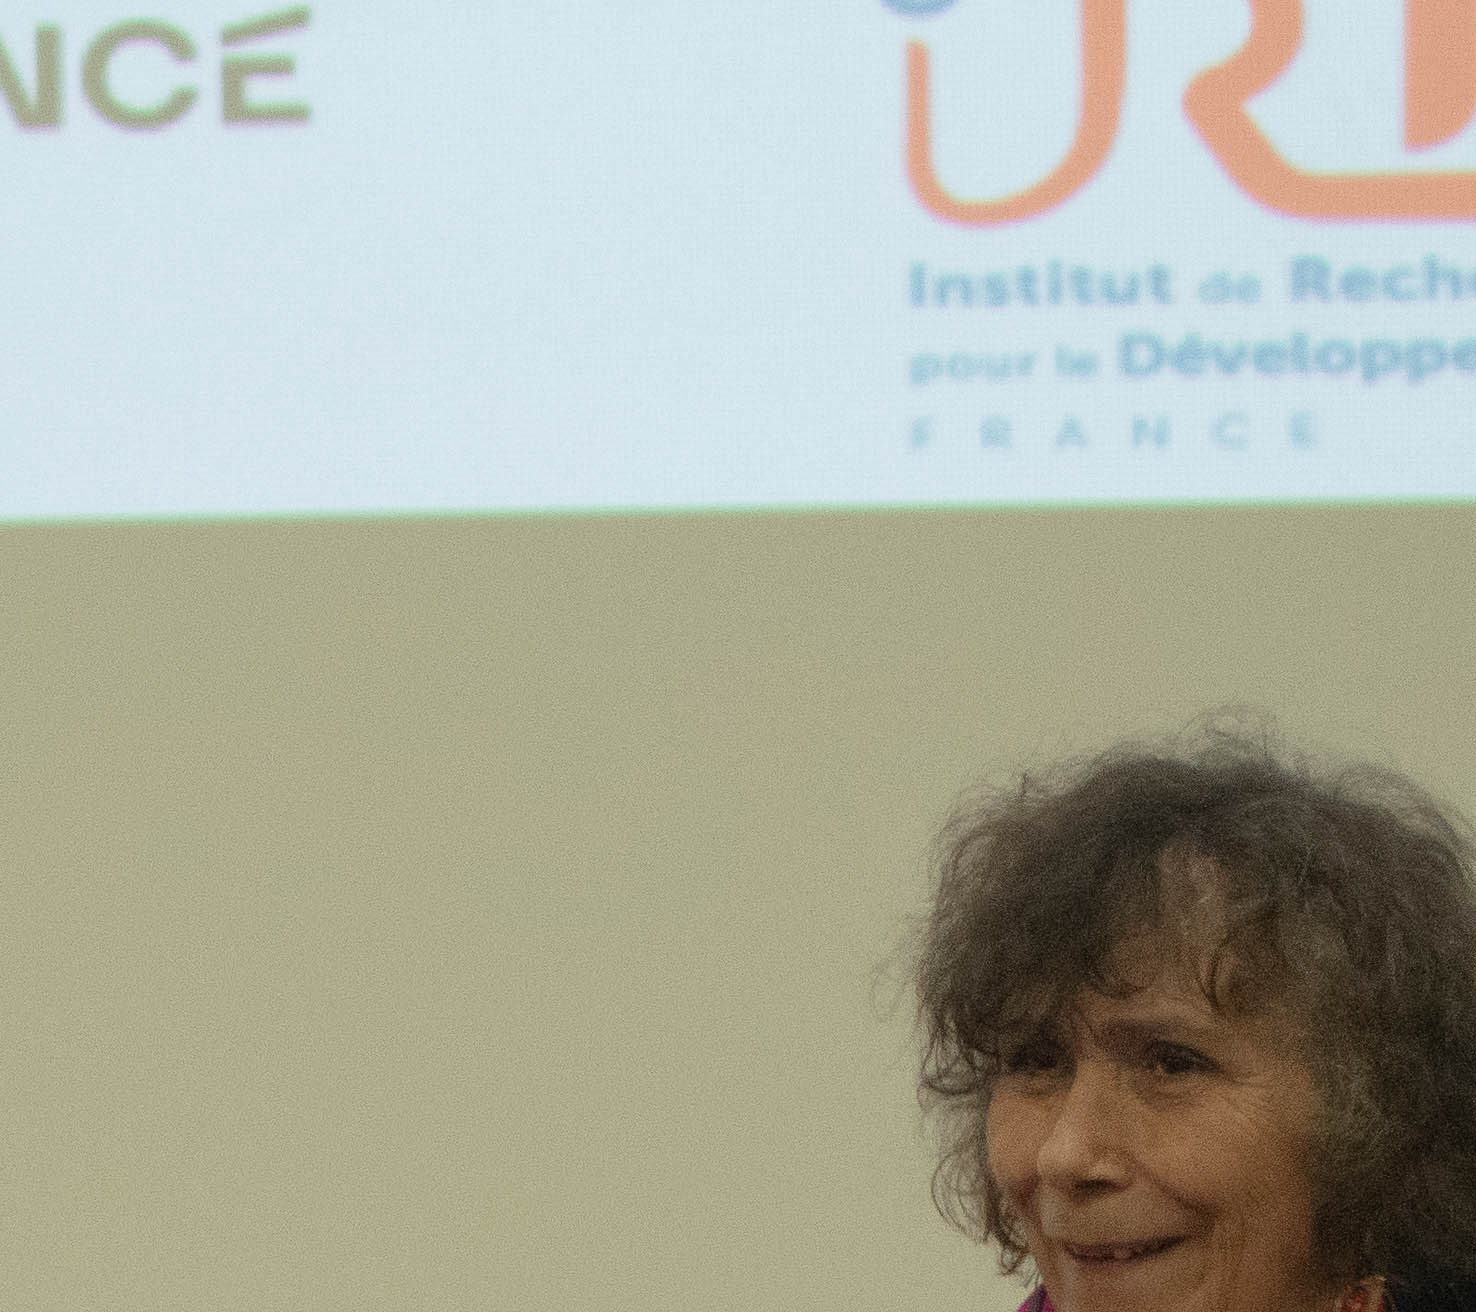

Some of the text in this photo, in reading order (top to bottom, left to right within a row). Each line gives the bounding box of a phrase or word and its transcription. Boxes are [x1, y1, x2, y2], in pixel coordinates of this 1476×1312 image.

[908, 259, 1174, 308] Institut
[1198, 270, 1262, 305] de
[908, 348, 1036, 386] pour
[1054, 345, 1099, 378] le
[908, 411, 1318, 452] FRANCE
